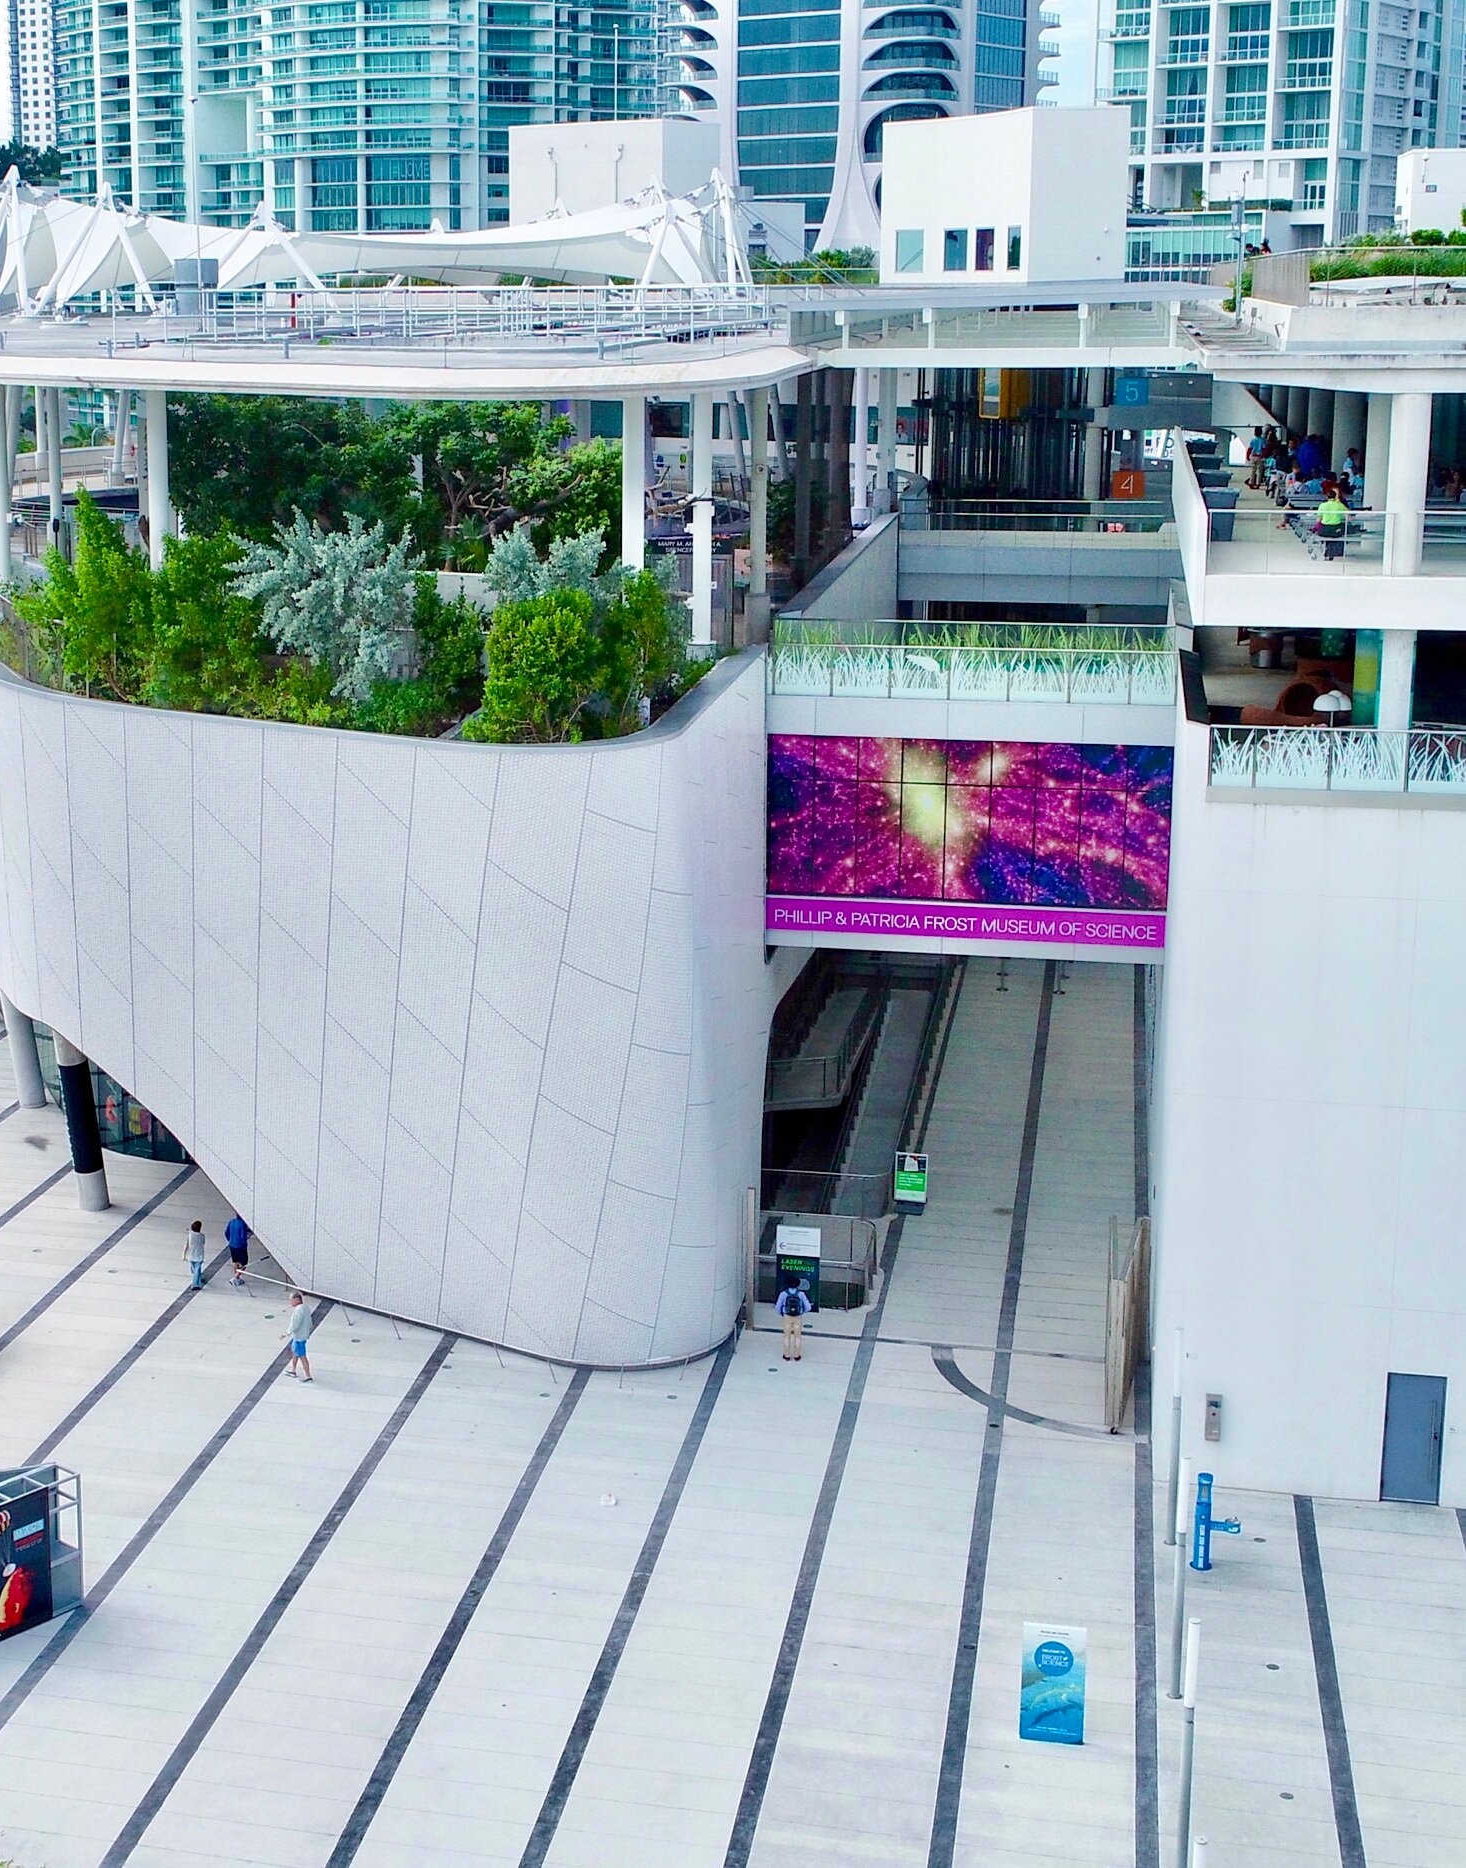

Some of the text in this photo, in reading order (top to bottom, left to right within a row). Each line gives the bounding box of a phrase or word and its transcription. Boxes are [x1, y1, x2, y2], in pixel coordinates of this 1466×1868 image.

[1125, 381, 1139, 402] 5
[1120, 474, 1134, 494] 4
[773, 908, 1157, 941] PHILLIP & PATRICIA FROST MUSEUM OF SCIENCE
[781, 1264, 815, 1272] EVENINGS
